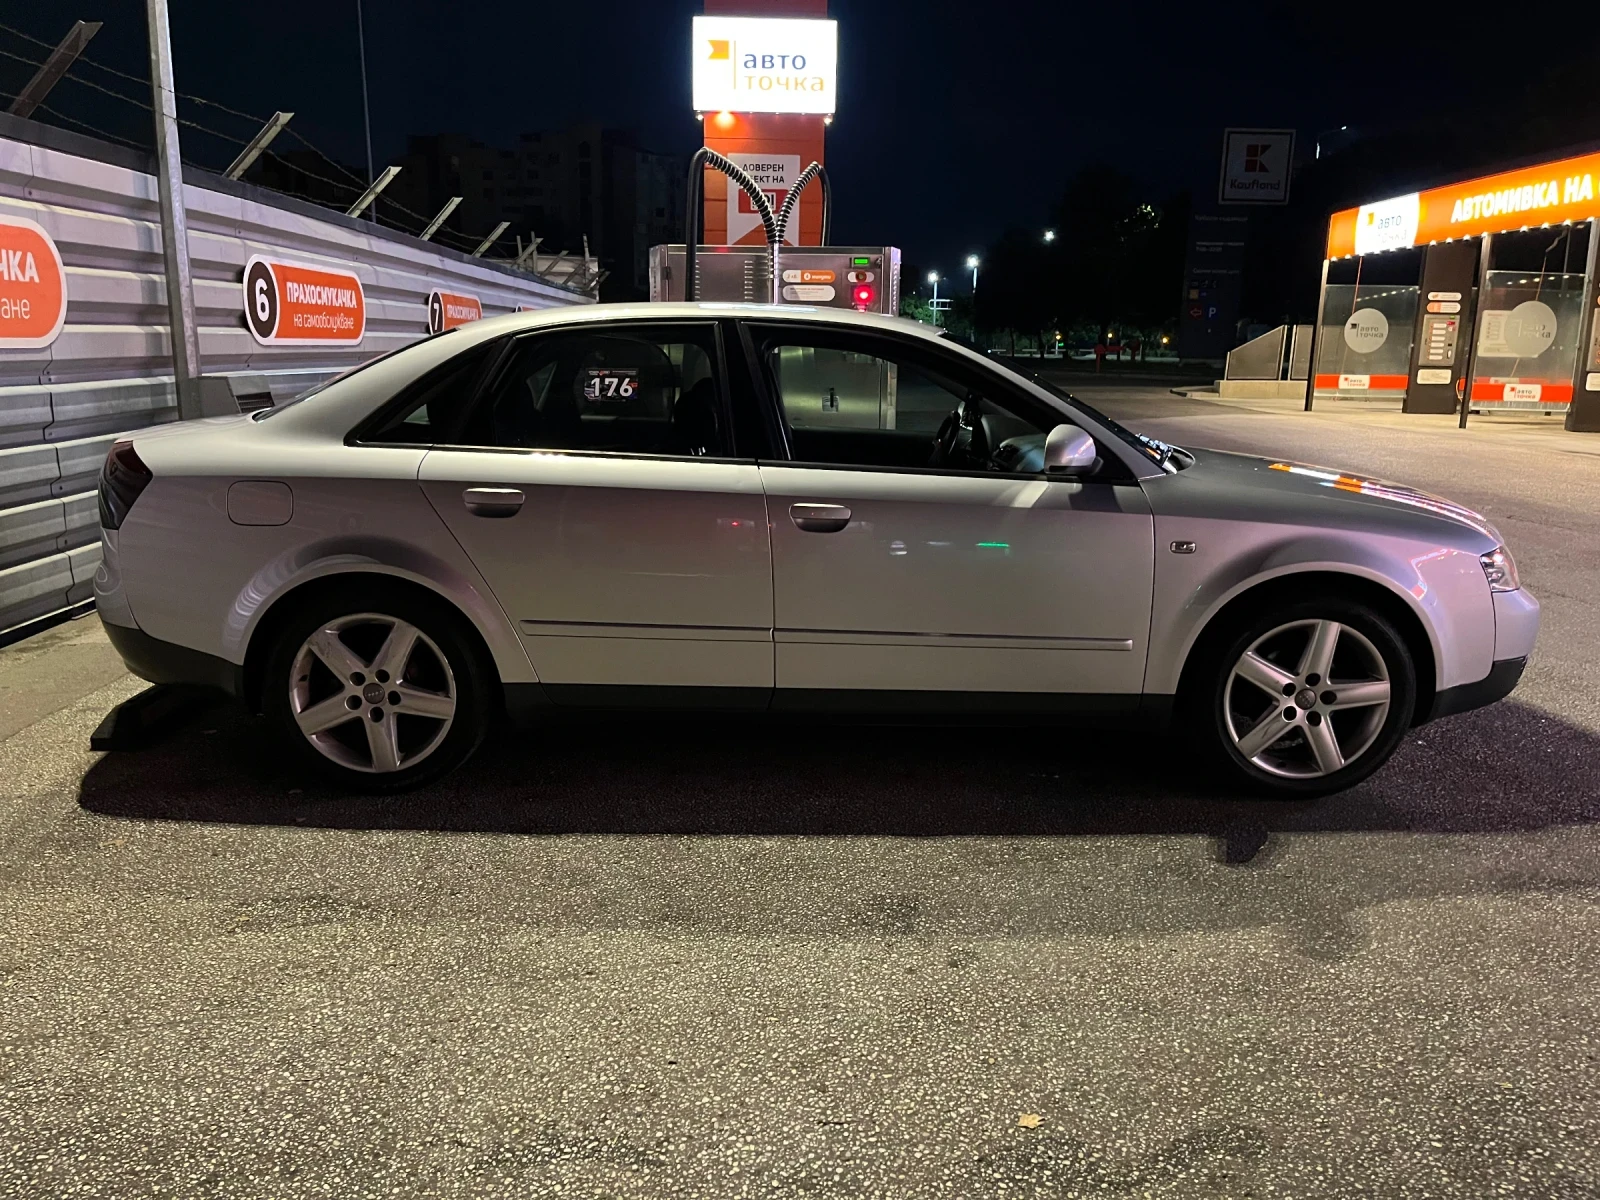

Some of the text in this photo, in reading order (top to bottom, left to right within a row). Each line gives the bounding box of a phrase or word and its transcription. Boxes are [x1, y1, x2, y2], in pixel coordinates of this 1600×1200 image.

[743, 53, 807, 70] авто
[744, 75, 825, 92] точка
[743, 163, 784, 173] ДОВЕРЕН
[1230, 178, 1281, 190] Kaufland
[1450, 174, 1593, 223] АВТОМИВКА НА
[1378, 215, 1402, 230] авто
[255, 278, 270, 322] 6
[286, 281, 358, 309] ПРАХОСМУКАЧКА
[433, 302, 440, 331] 7
[1208, 307, 1217, 318] P
[293, 311, 355, 333] на самообслужване
[590, 377, 633, 397] 176
